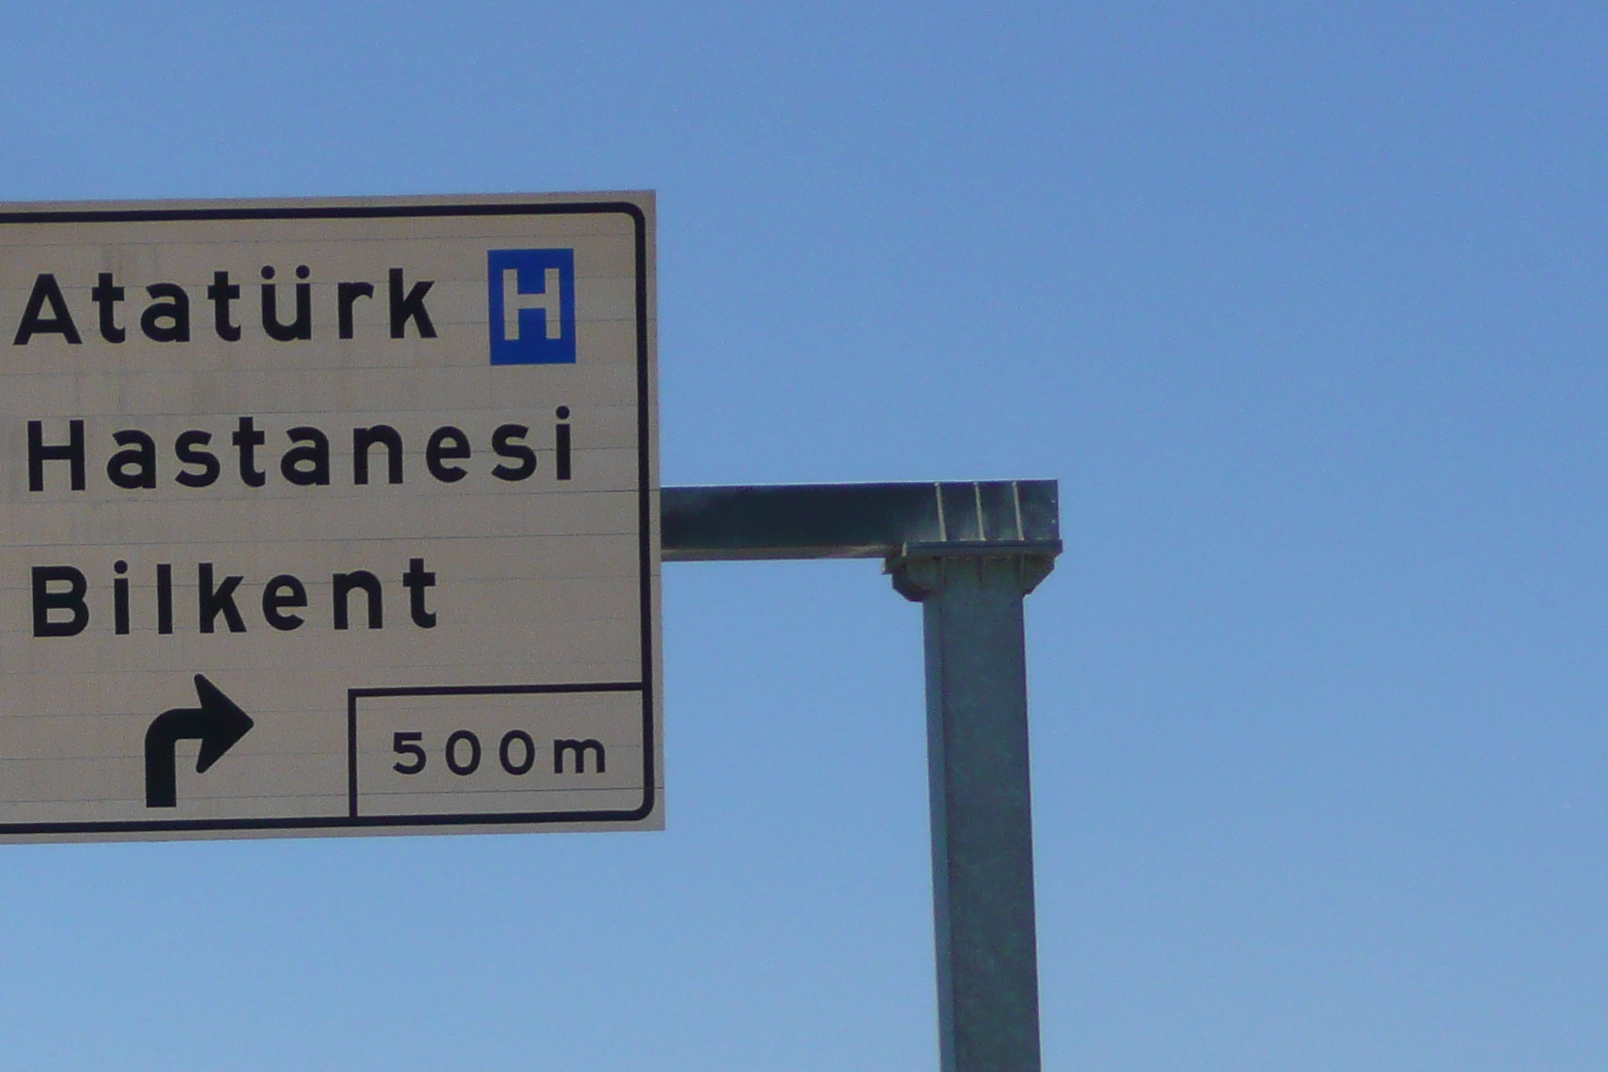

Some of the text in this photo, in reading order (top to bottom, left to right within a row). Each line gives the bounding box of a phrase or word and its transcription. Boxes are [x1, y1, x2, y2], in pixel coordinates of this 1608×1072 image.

[12, 264, 562, 346] Atatürk H
[27, 405, 572, 492] Hastanesi
[30, 557, 438, 638] Bilkent
[392, 729, 606, 776] 500m
